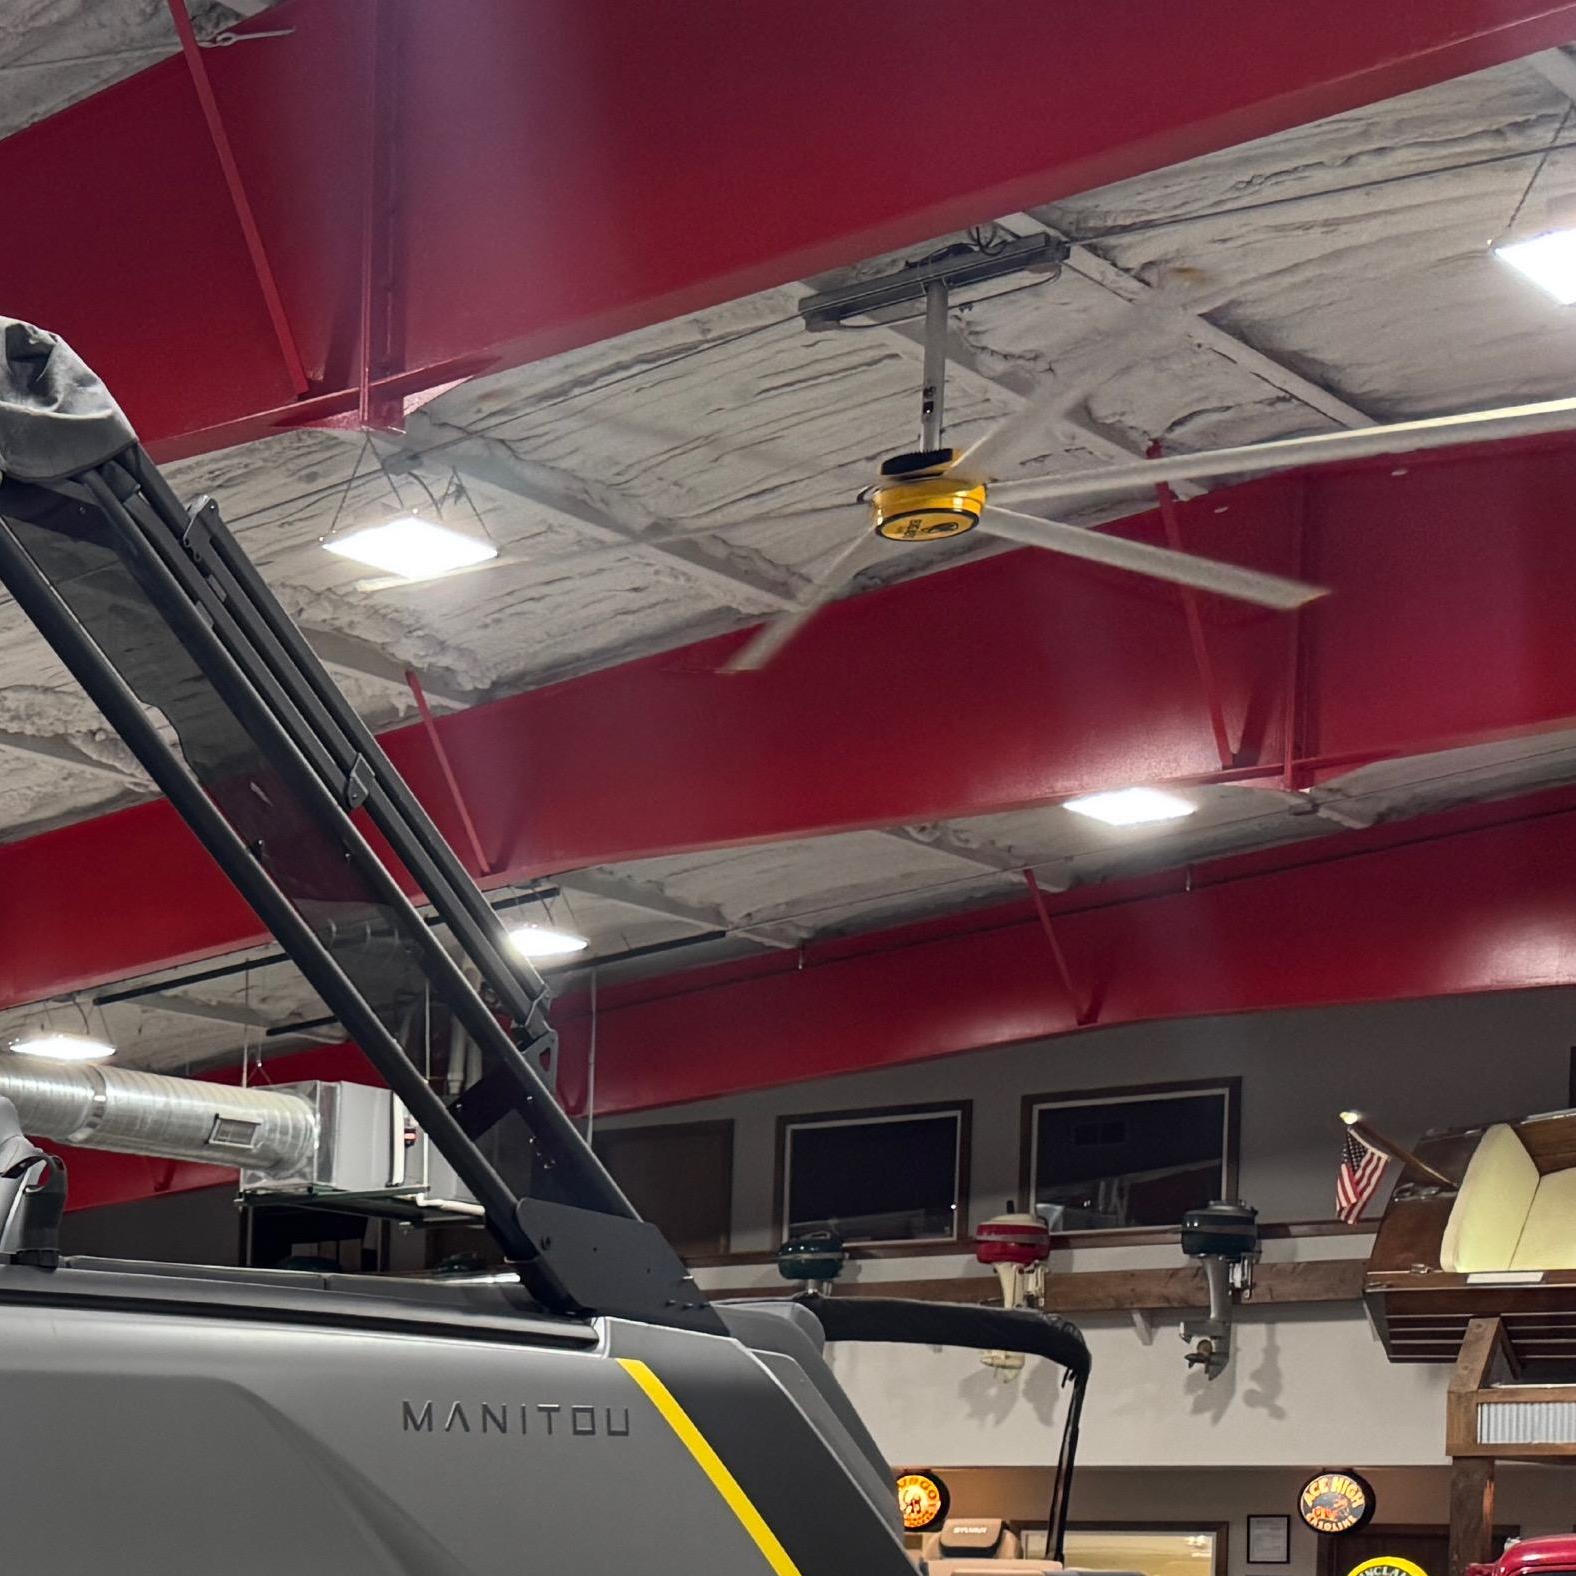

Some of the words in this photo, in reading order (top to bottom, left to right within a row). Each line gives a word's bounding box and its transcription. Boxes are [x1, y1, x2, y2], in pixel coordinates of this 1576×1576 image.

[401, 1399, 630, 1436] MANITOU
[1303, 1478, 1329, 1508] ACE
[1330, 1476, 1365, 1508] HIGH
